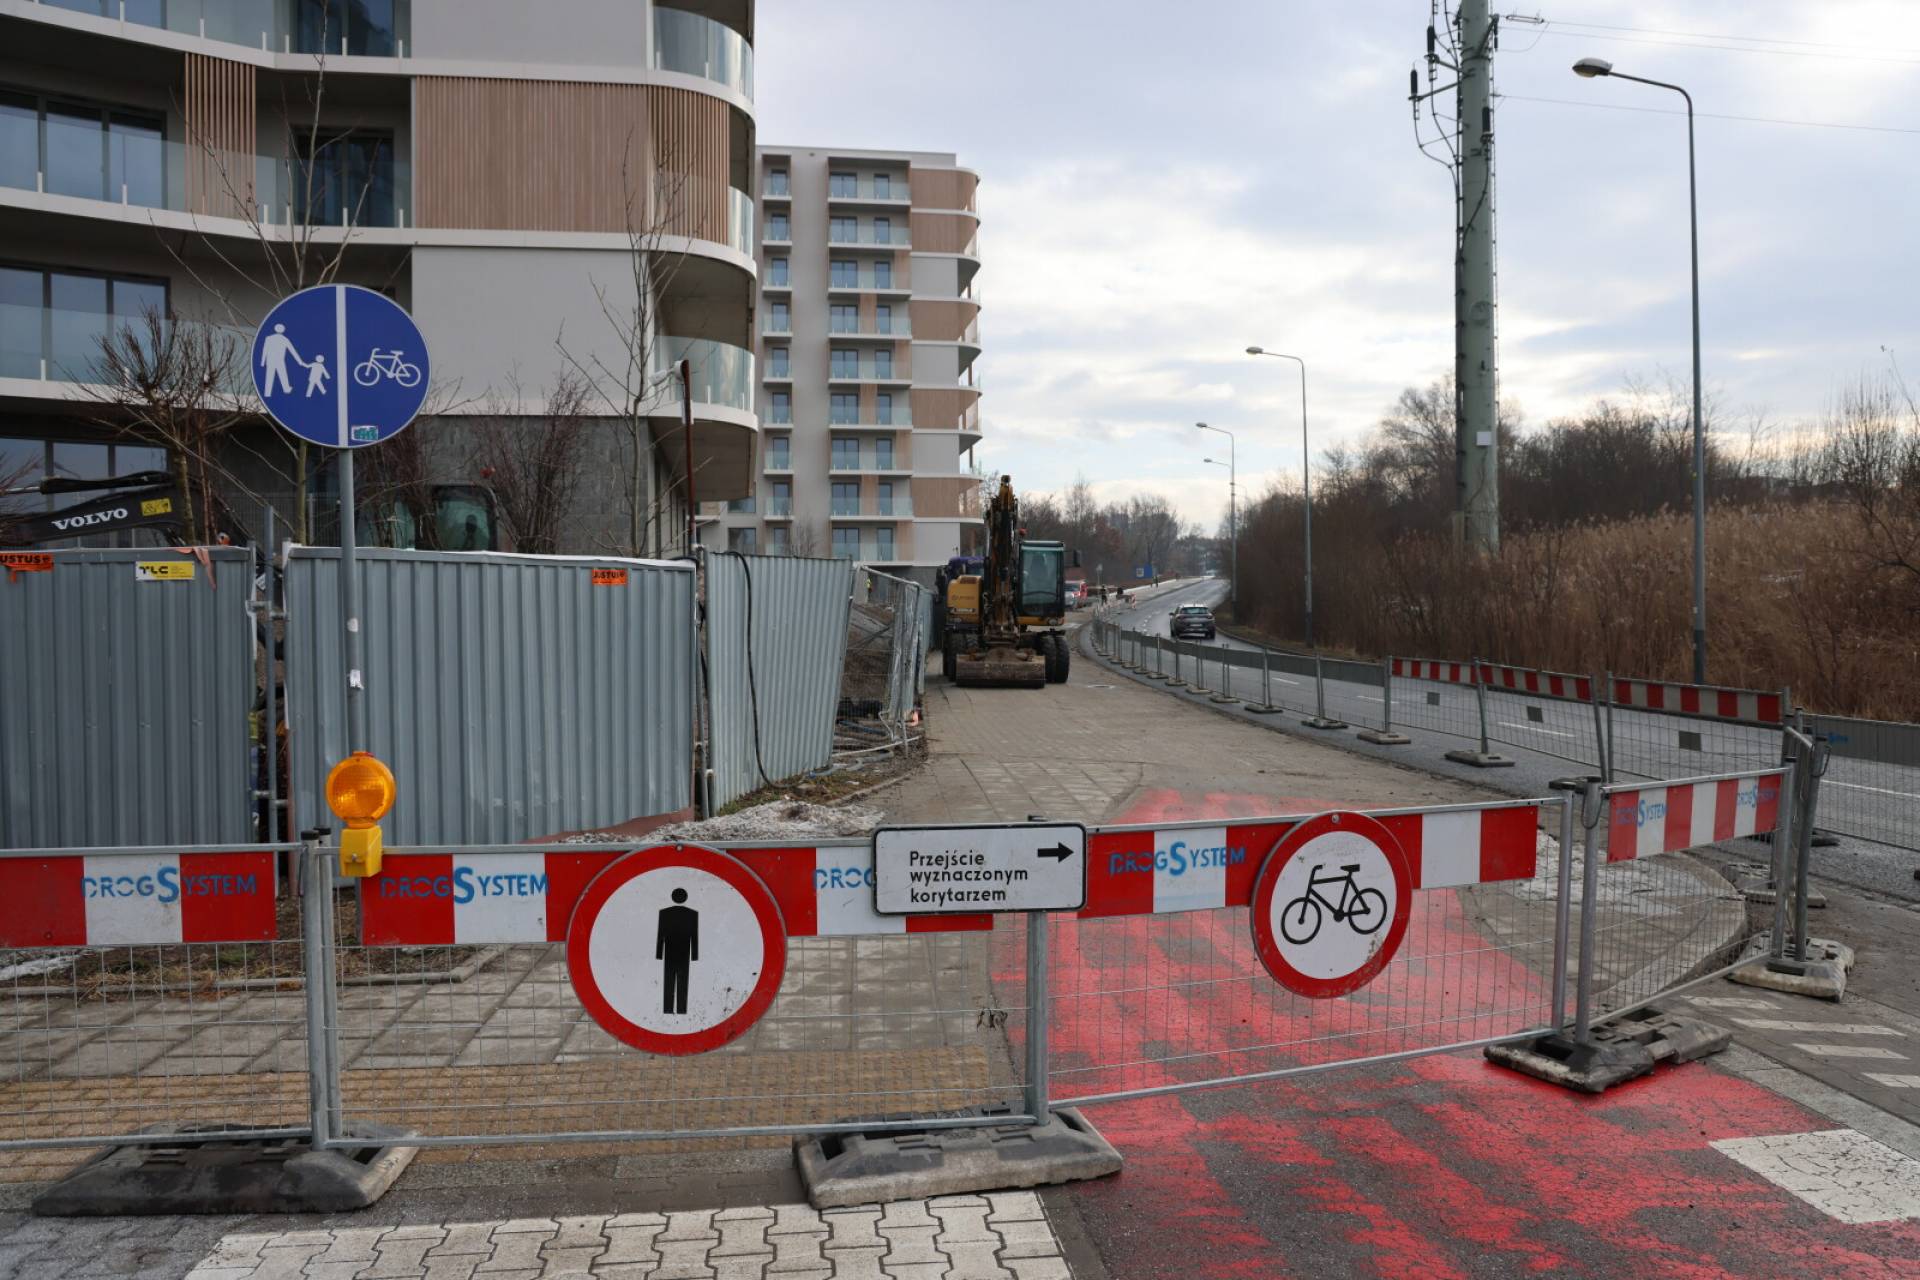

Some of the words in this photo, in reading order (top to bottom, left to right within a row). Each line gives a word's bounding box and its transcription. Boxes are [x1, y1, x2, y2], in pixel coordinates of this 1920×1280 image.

[51, 508, 128, 530] VOLVO
[909, 850, 985, 869] Przejście
[1109, 841, 1246, 876] DROGSYSTEM
[81, 866, 257, 903] DROGSYSTEM
[379, 866, 549, 904] DROGSYSTEM
[909, 867, 1029, 888] wyznaczonym
[910, 887, 1007, 907] korytarzem
